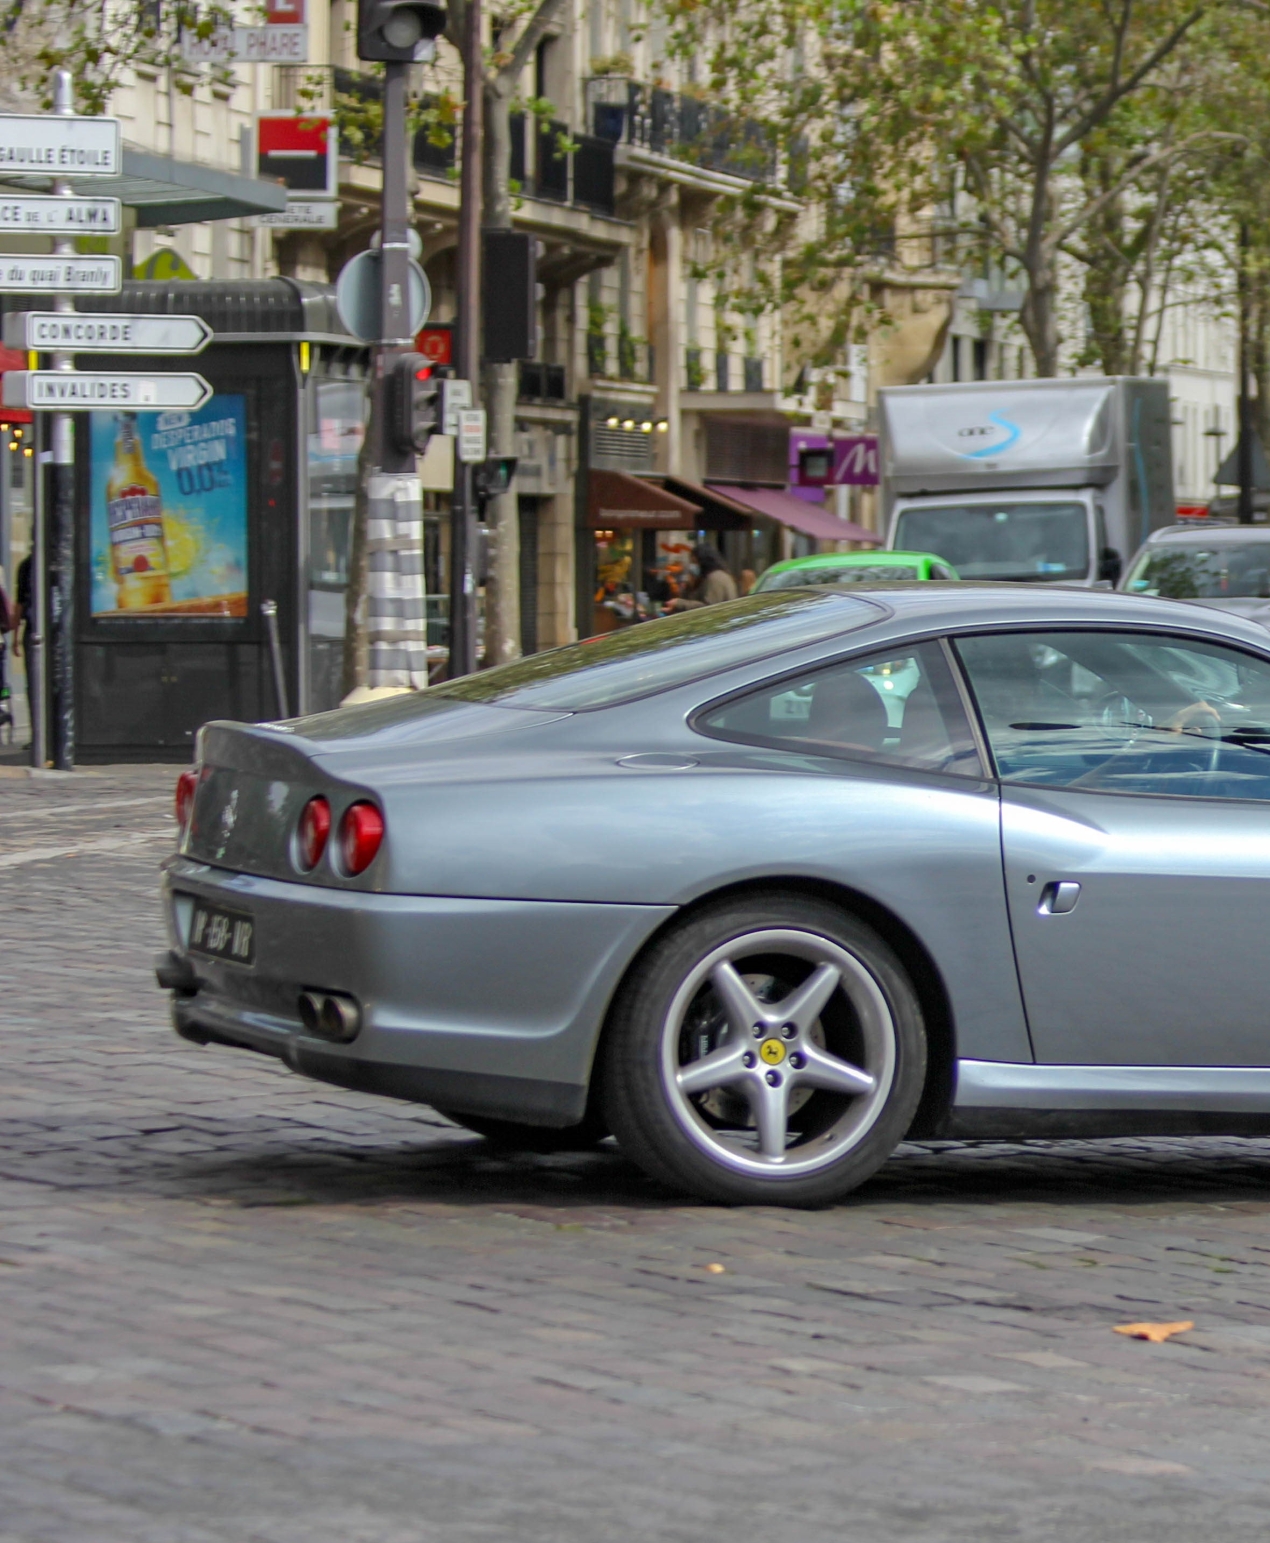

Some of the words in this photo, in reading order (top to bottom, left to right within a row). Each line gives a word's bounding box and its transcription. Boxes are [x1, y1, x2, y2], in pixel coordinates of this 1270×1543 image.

[246, 32, 300, 56] PHARE
[65, 206, 111, 223] ALMA
[8, 266, 25, 281] du
[30, 266, 61, 285] quai
[64, 265, 110, 286] Branly
[37, 323, 132, 341] CONCORDE
[38, 381, 131, 399] INVALIDES
[151, 418, 236, 450] DESPERADOS
[167, 439, 226, 471] VIRGIN
